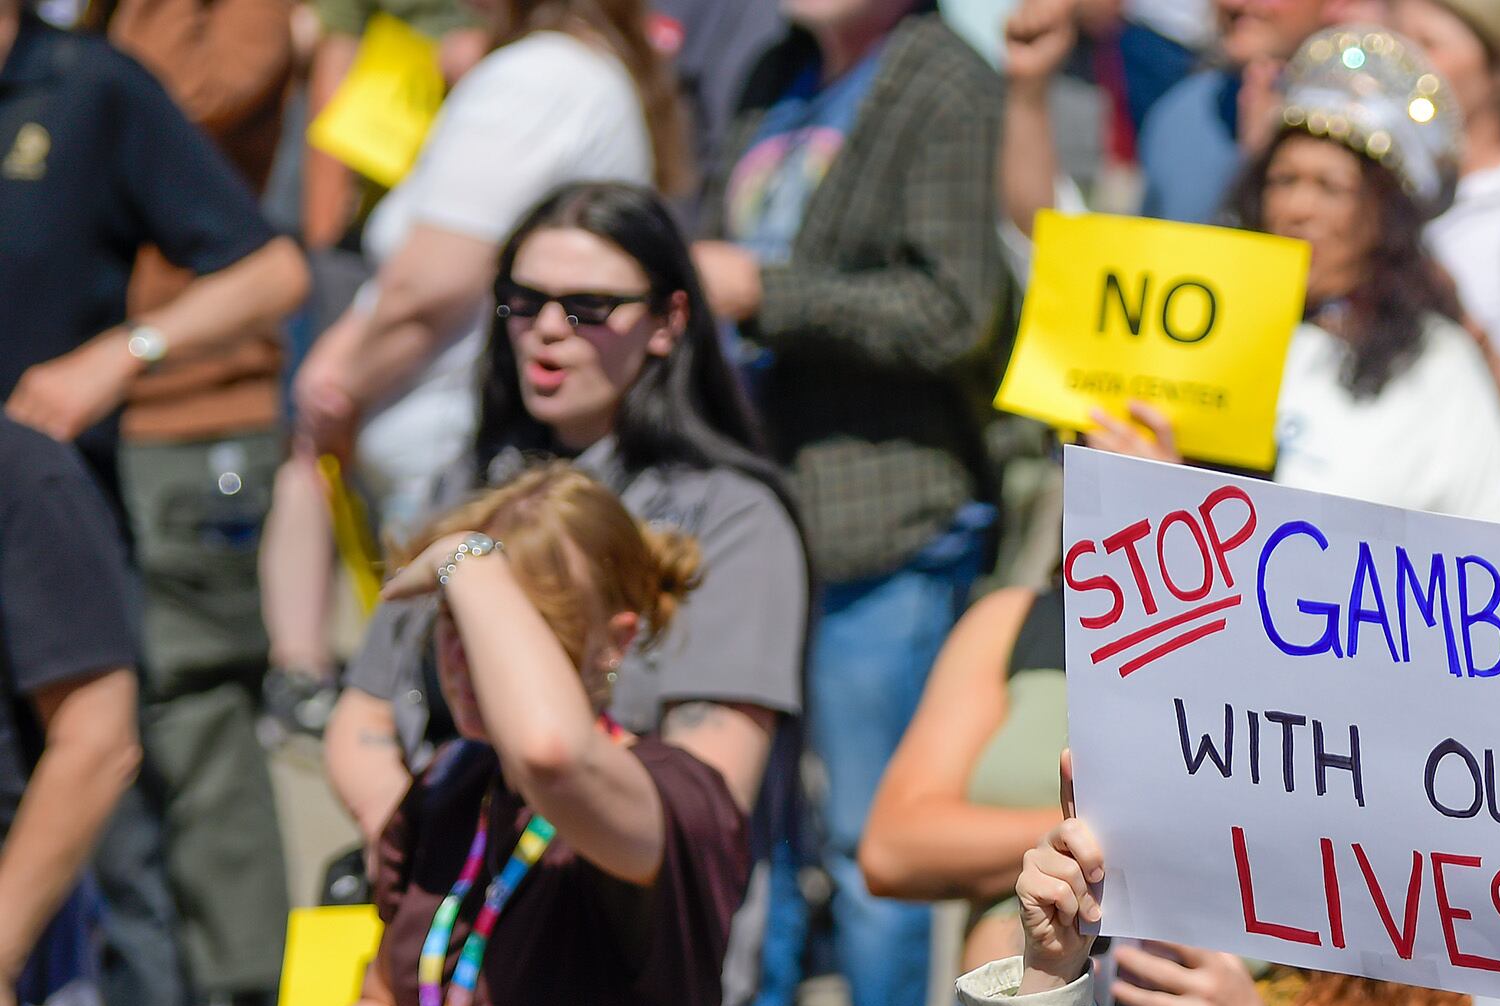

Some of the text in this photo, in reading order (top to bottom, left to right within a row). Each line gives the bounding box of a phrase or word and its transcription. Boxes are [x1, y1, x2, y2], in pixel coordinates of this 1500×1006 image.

[1096, 271, 1221, 346] NO
[1130, 372, 1230, 411] CENTER
[1064, 484, 1258, 630] STOP
[1174, 697, 1366, 807] WITH
